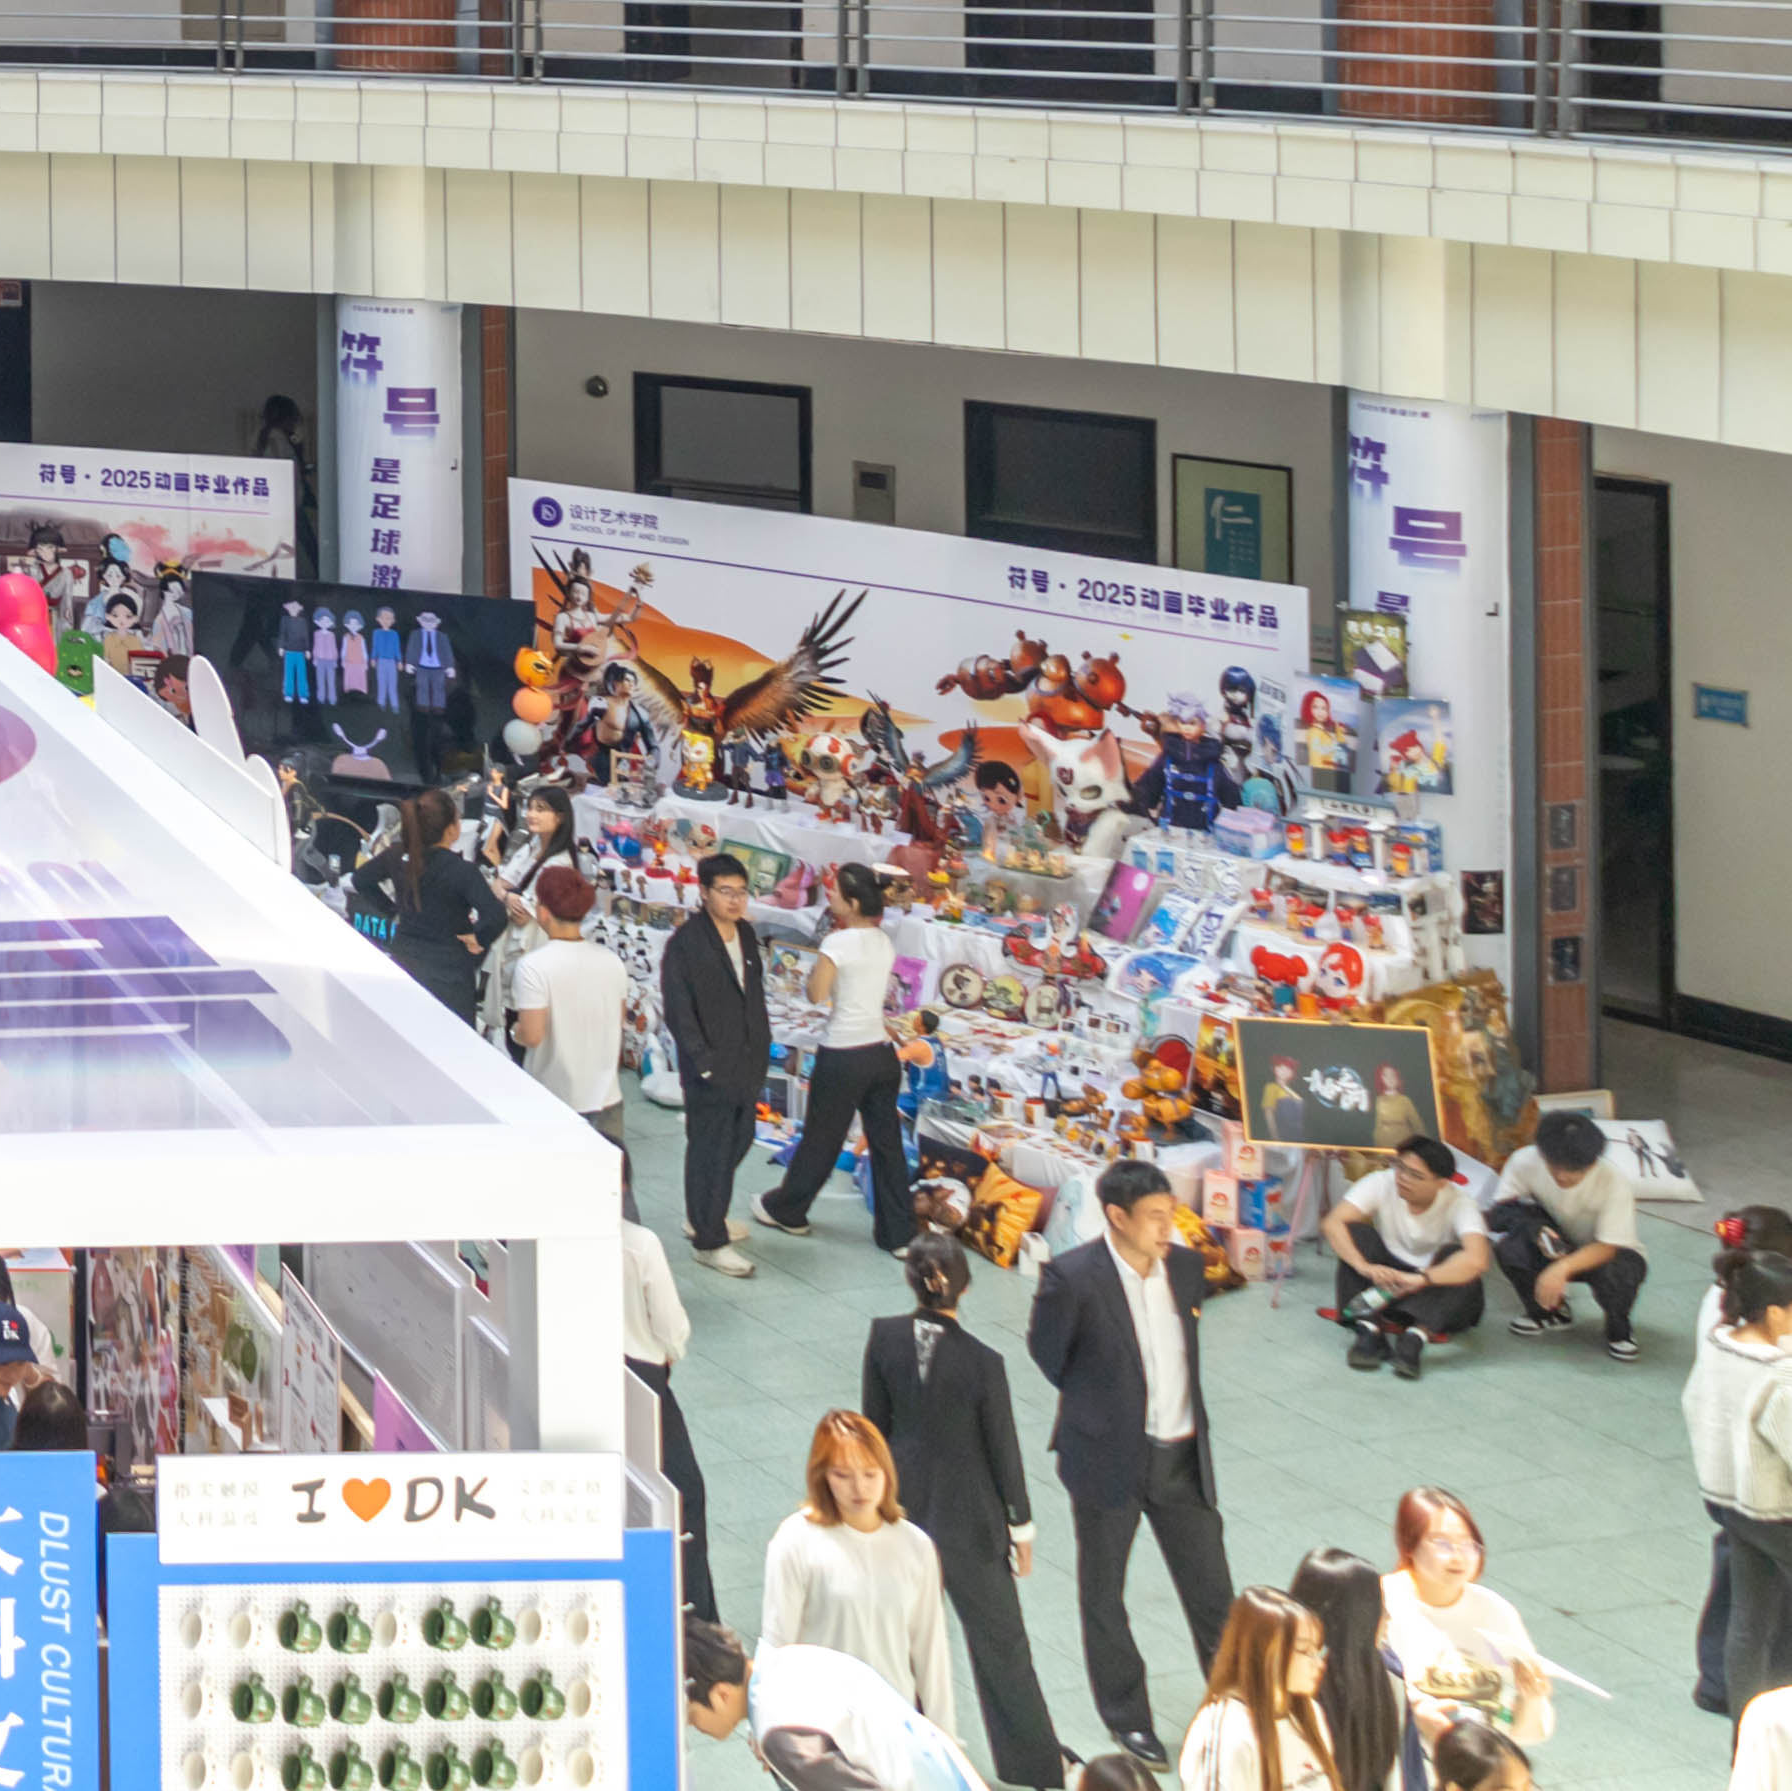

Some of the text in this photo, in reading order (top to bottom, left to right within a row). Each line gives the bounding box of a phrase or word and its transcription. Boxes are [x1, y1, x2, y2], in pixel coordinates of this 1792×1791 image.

[569, 504, 658, 529] 设计艺术学院
[1210, 495, 1254, 540] 仁
[292, 1475, 496, 1523] I DK
[39, 1511, 72, 1791] DLUST CULTUR
